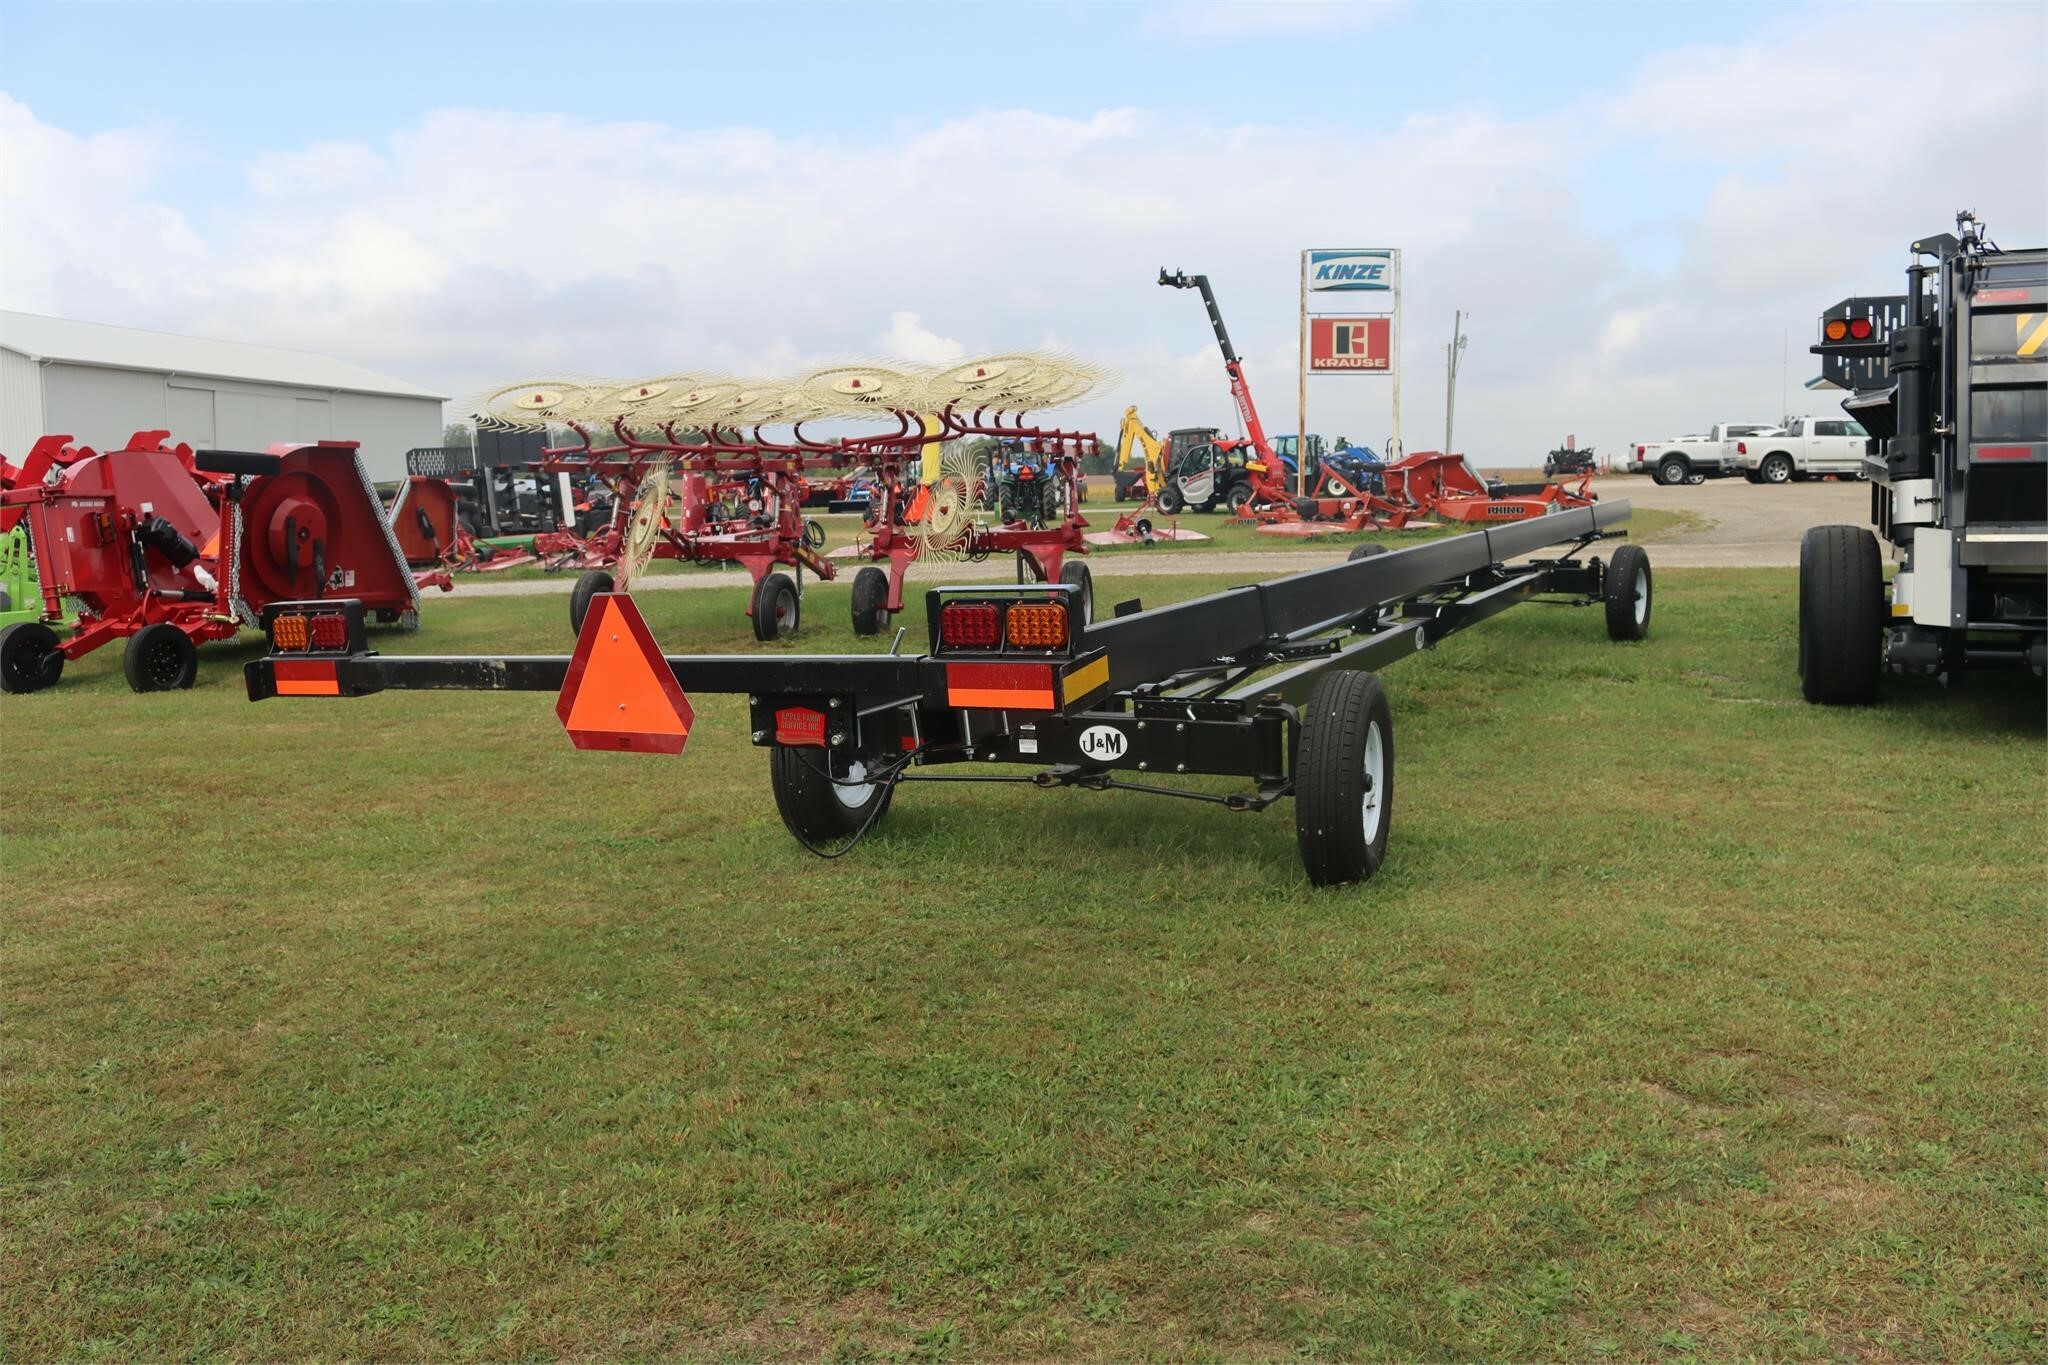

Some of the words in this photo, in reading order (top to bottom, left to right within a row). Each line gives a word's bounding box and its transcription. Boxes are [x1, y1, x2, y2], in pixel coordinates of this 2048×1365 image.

[1315, 264, 1386, 280] KINZE
[1314, 358, 1386, 368] KRAUSE
[1234, 380, 1253, 423] MANITOU
[1487, 506, 1525, 515] RHINO
[781, 711, 801, 721] APPLE
[802, 712, 821, 722] FARM
[781, 720, 807, 730] SERVICE
[1082, 732, 1122, 754] J&M
